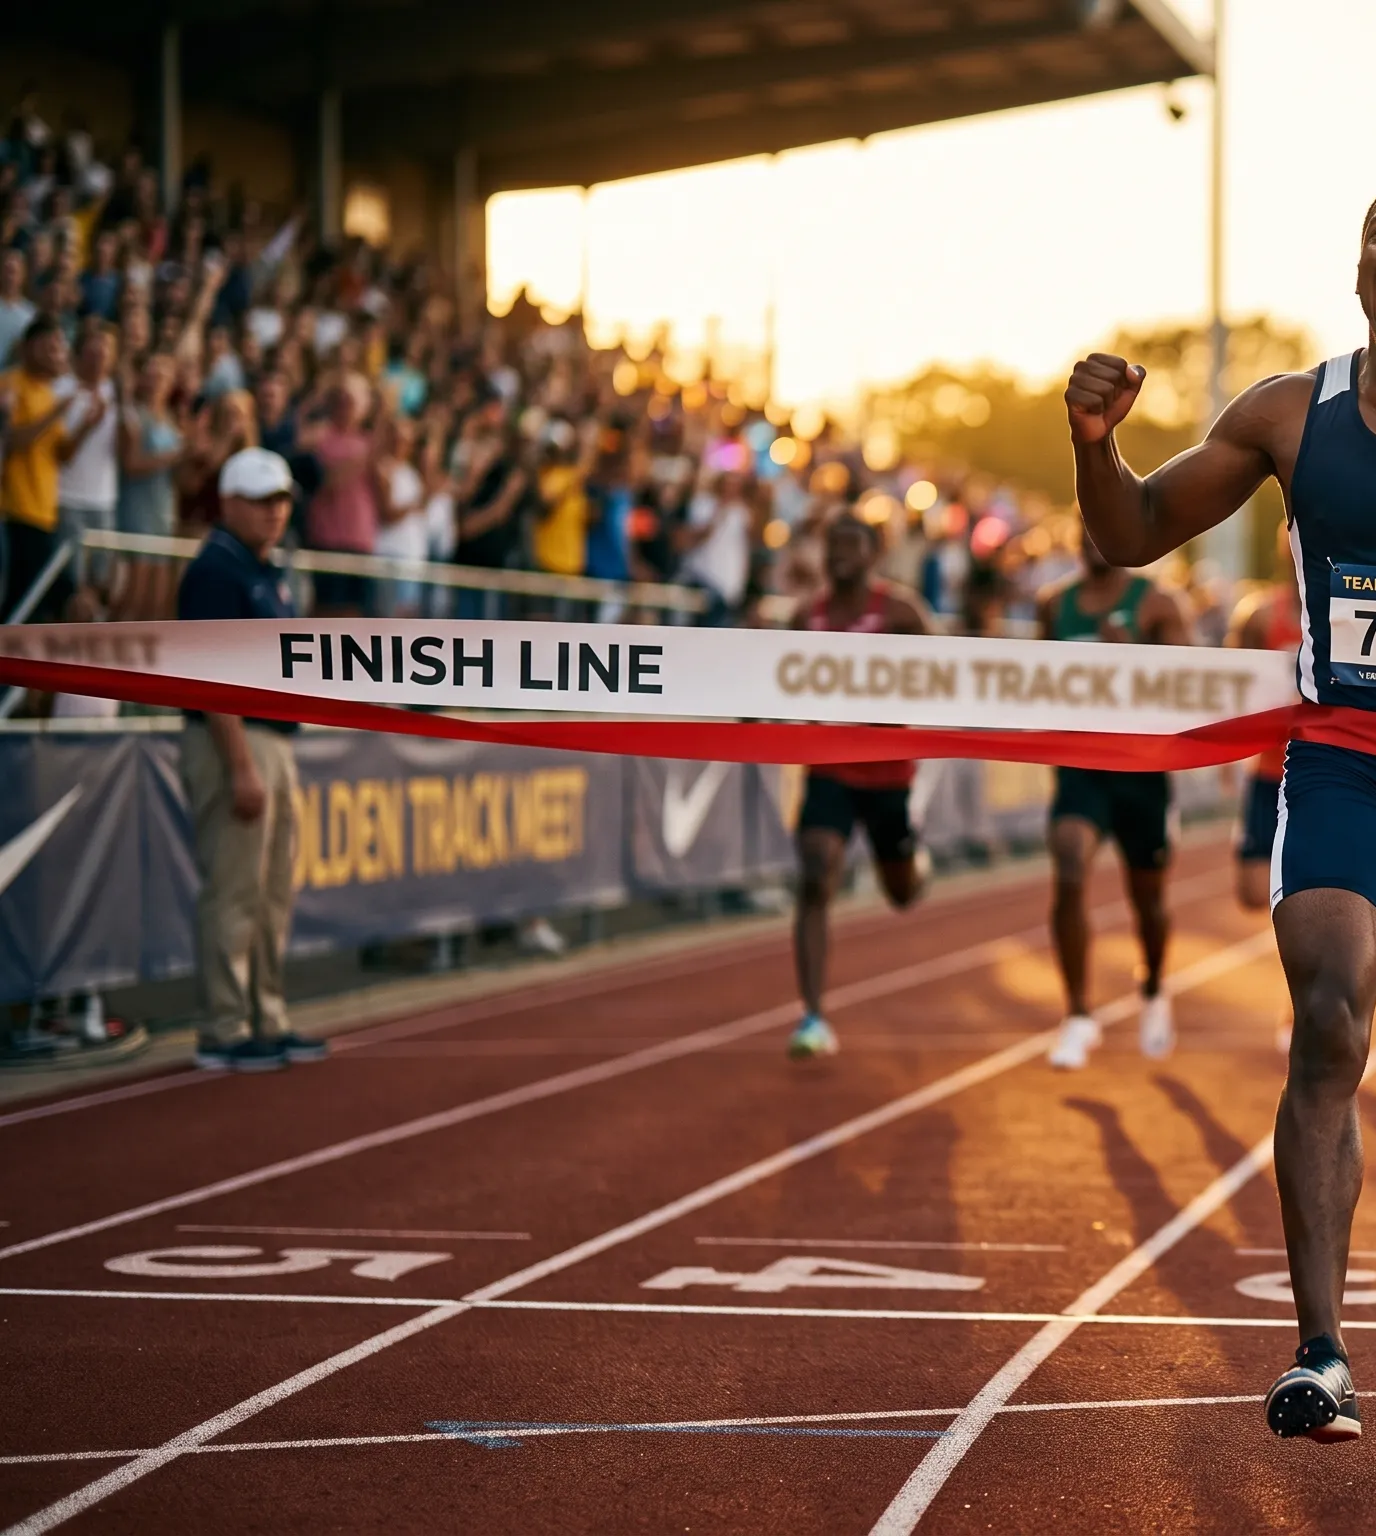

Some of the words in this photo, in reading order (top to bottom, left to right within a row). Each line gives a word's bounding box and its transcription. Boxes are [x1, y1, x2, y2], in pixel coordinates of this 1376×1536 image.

[279, 632, 494, 688] FINISH
[519, 640, 663, 695] LINE
[776, 653, 957, 699] GOLDEN
[970, 660, 1119, 706] TRACK
[1130, 668, 1256, 714] MEET
[103, 1245, 455, 1282] 5
[638, 1255, 987, 1293] 4
